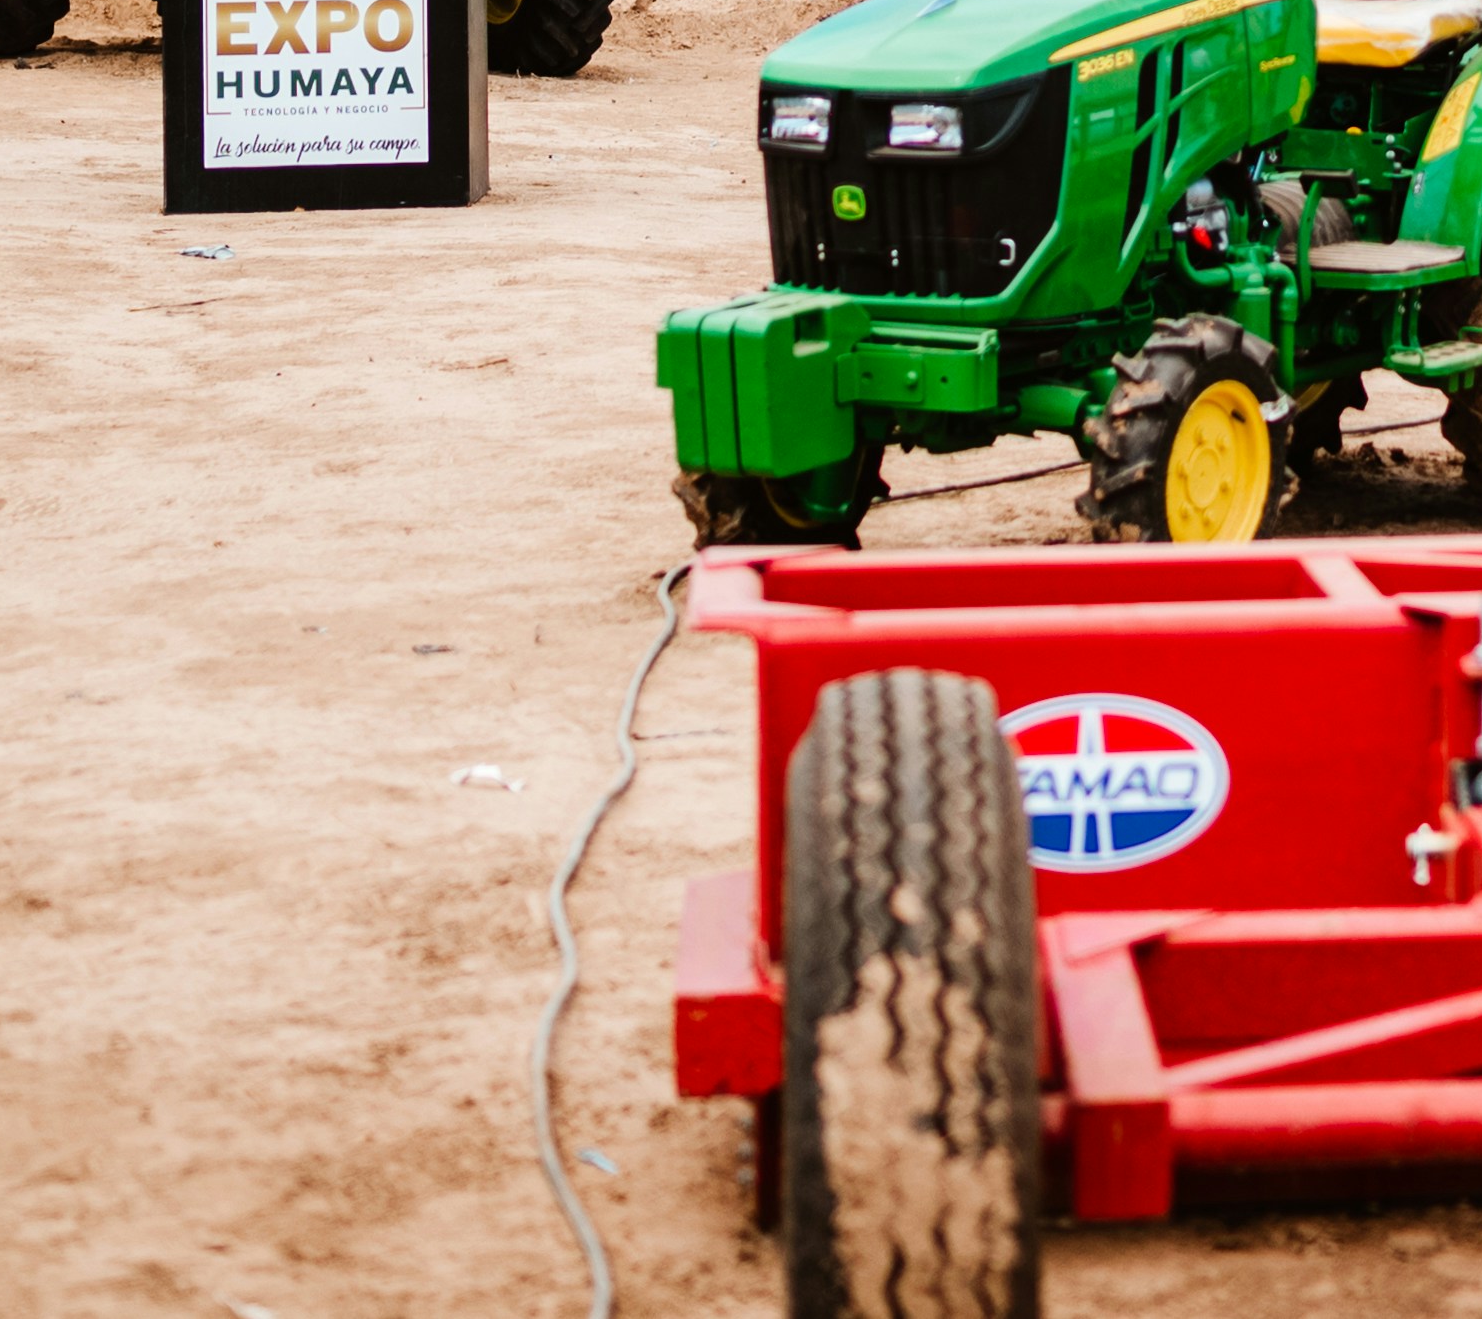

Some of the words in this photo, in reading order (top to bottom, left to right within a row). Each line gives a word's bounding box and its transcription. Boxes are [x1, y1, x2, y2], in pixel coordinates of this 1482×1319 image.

[216, 66, 415, 99] HUMAYA
[244, 106, 318, 117] TECNOLOGÍA
[324, 106, 330, 114] Y
[336, 104, 389, 114] NEGOCIO
[213, 136, 232, 158] La
[235, 134, 296, 158] solución
[296, 135, 342, 163] para
[345, 137, 366, 155] su
